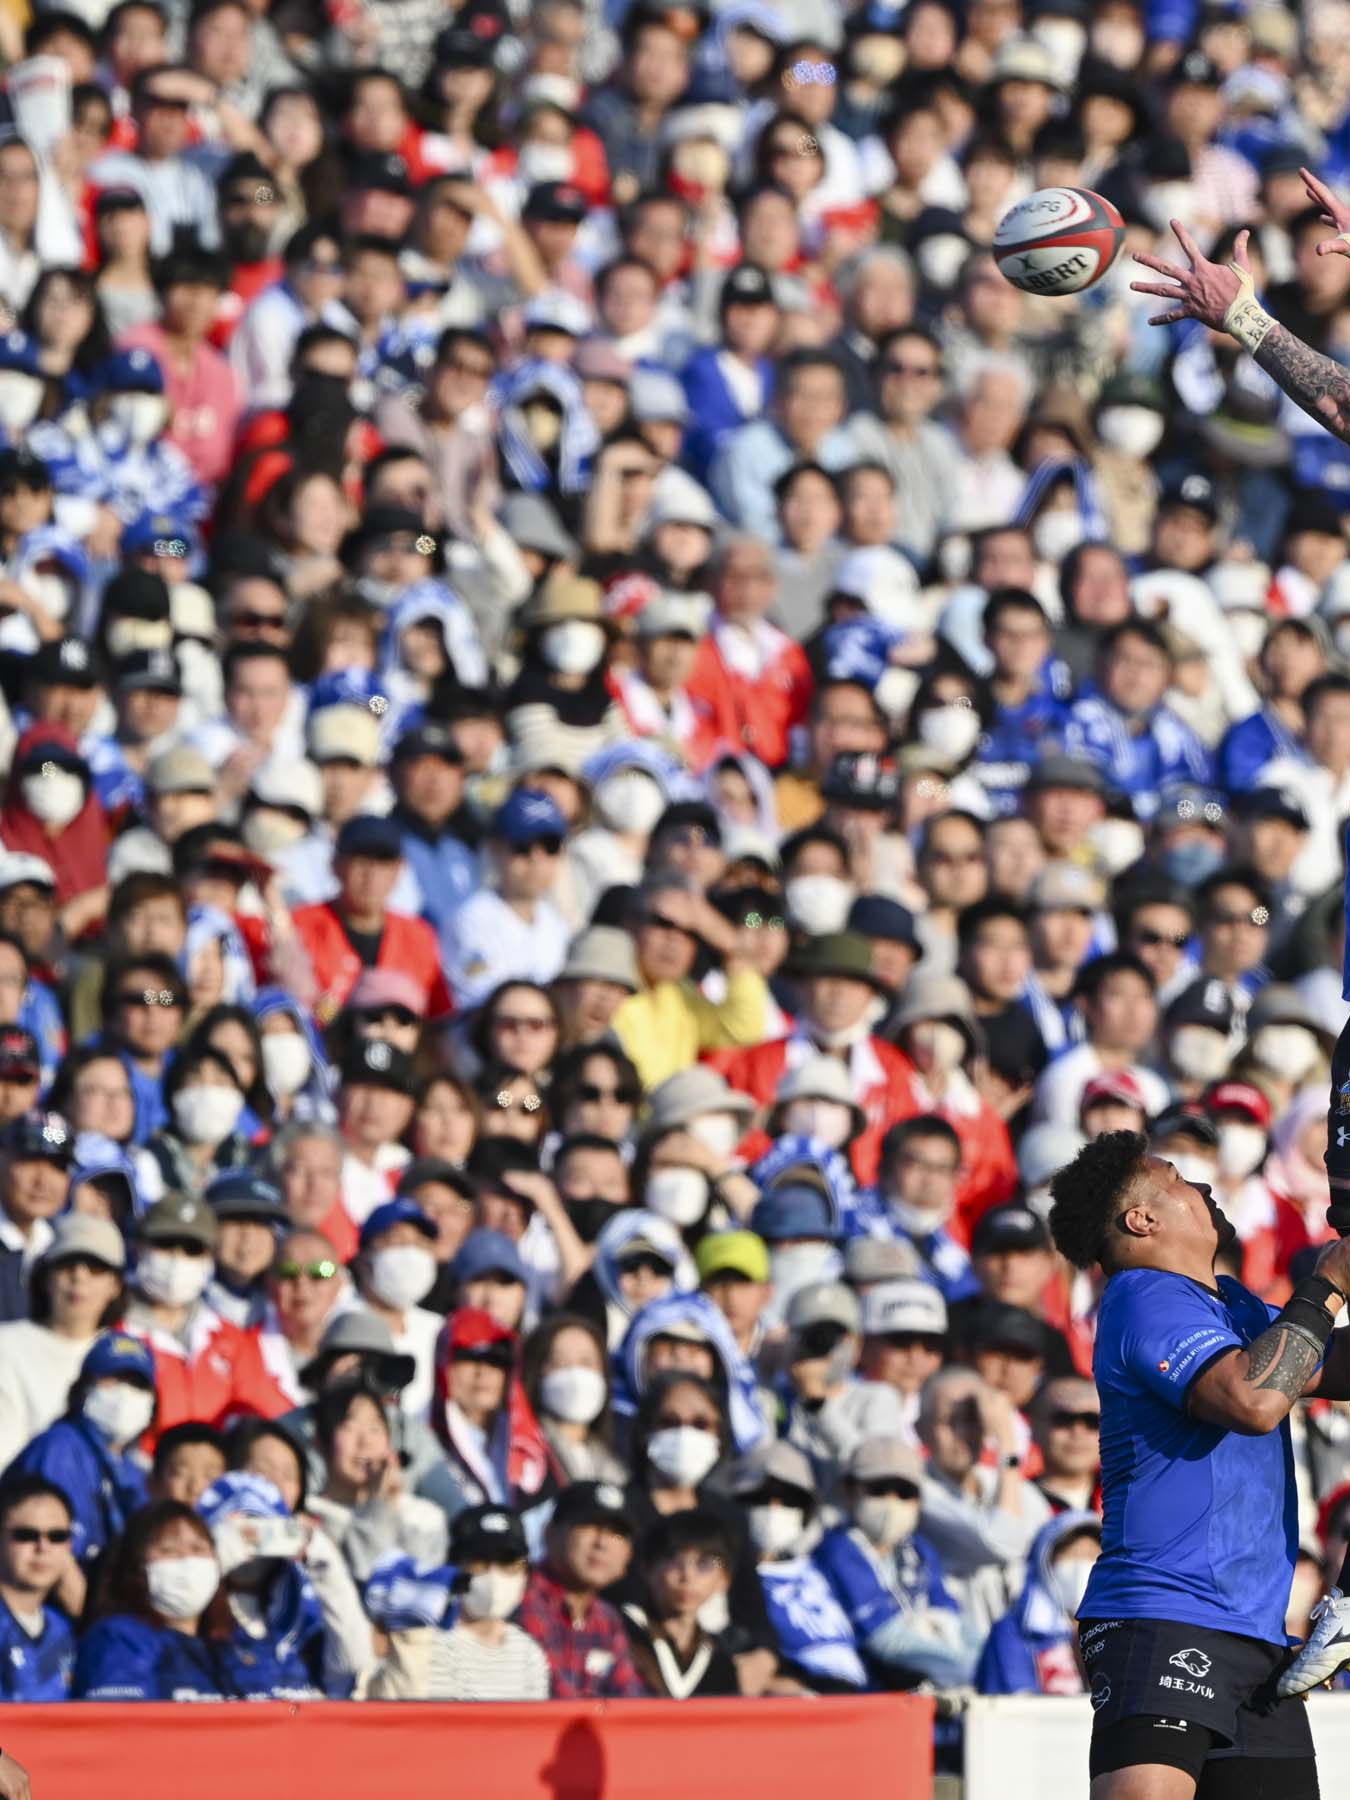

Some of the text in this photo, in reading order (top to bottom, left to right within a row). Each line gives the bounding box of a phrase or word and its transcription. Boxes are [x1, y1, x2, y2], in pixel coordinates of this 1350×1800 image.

[1159, 1675, 1215, 1699] 埼玉スバル
